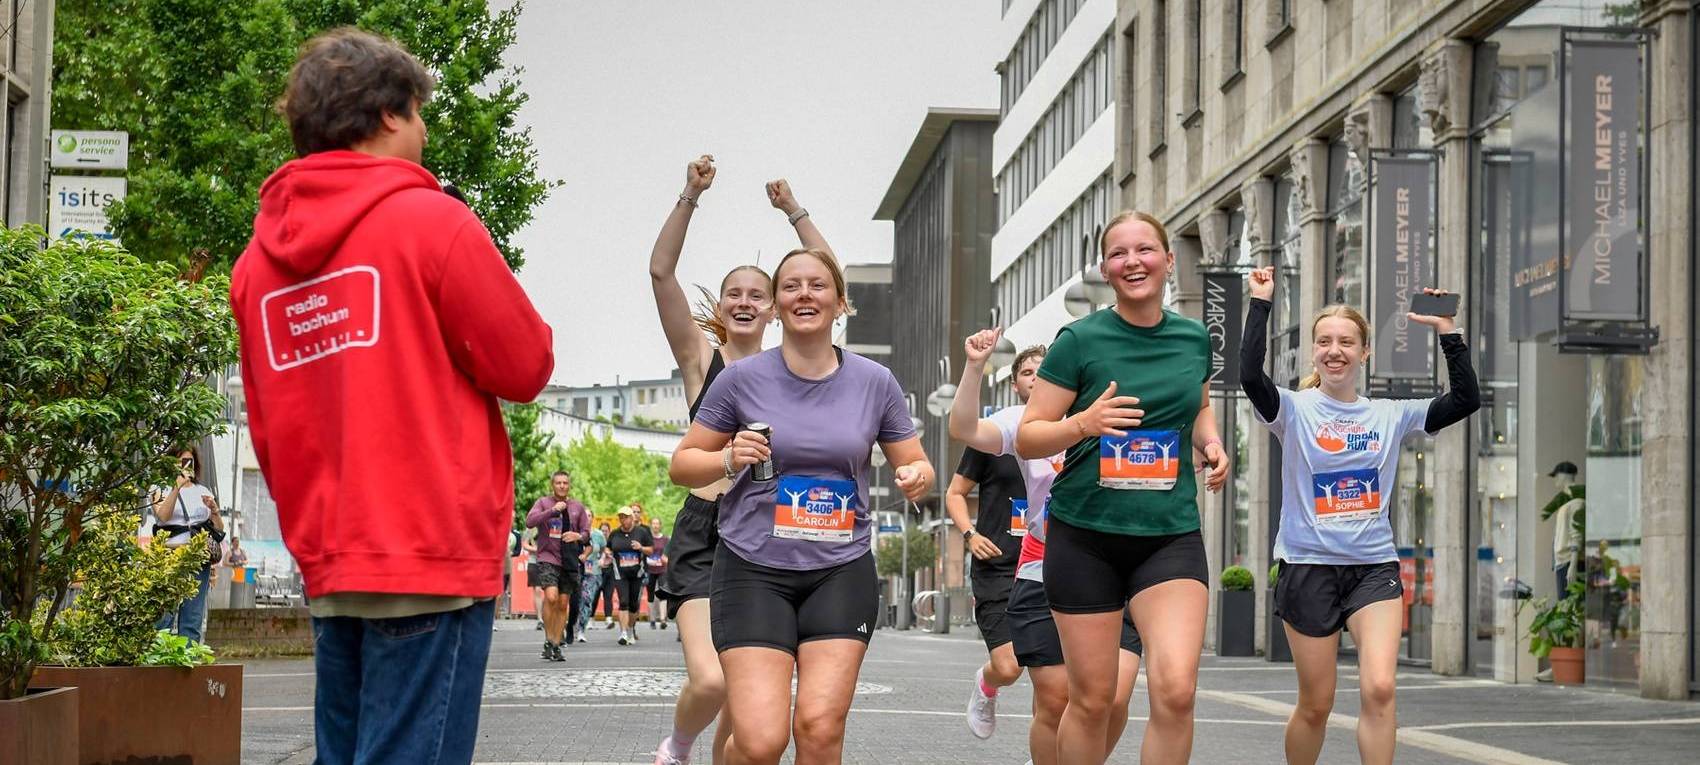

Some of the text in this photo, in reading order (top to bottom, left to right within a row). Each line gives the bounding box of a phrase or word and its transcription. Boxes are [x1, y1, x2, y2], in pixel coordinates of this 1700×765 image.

[80, 146, 115, 154] service
[1618, 131, 1627, 165] YVES
[1618, 168, 1627, 195] UND
[58, 187, 114, 207] isits
[285, 294, 328, 317] radio
[289, 307, 349, 336] bochum
[1347, 430, 1379, 441] URBAN
[1347, 440, 1368, 451] RUN
[1129, 453, 1155, 464] 4678
[1338, 490, 1360, 500] 3322
[806, 502, 833, 515] 3406
[1335, 501, 1365, 510] SOPHIE
[796, 515, 839, 527] CAROLIN
